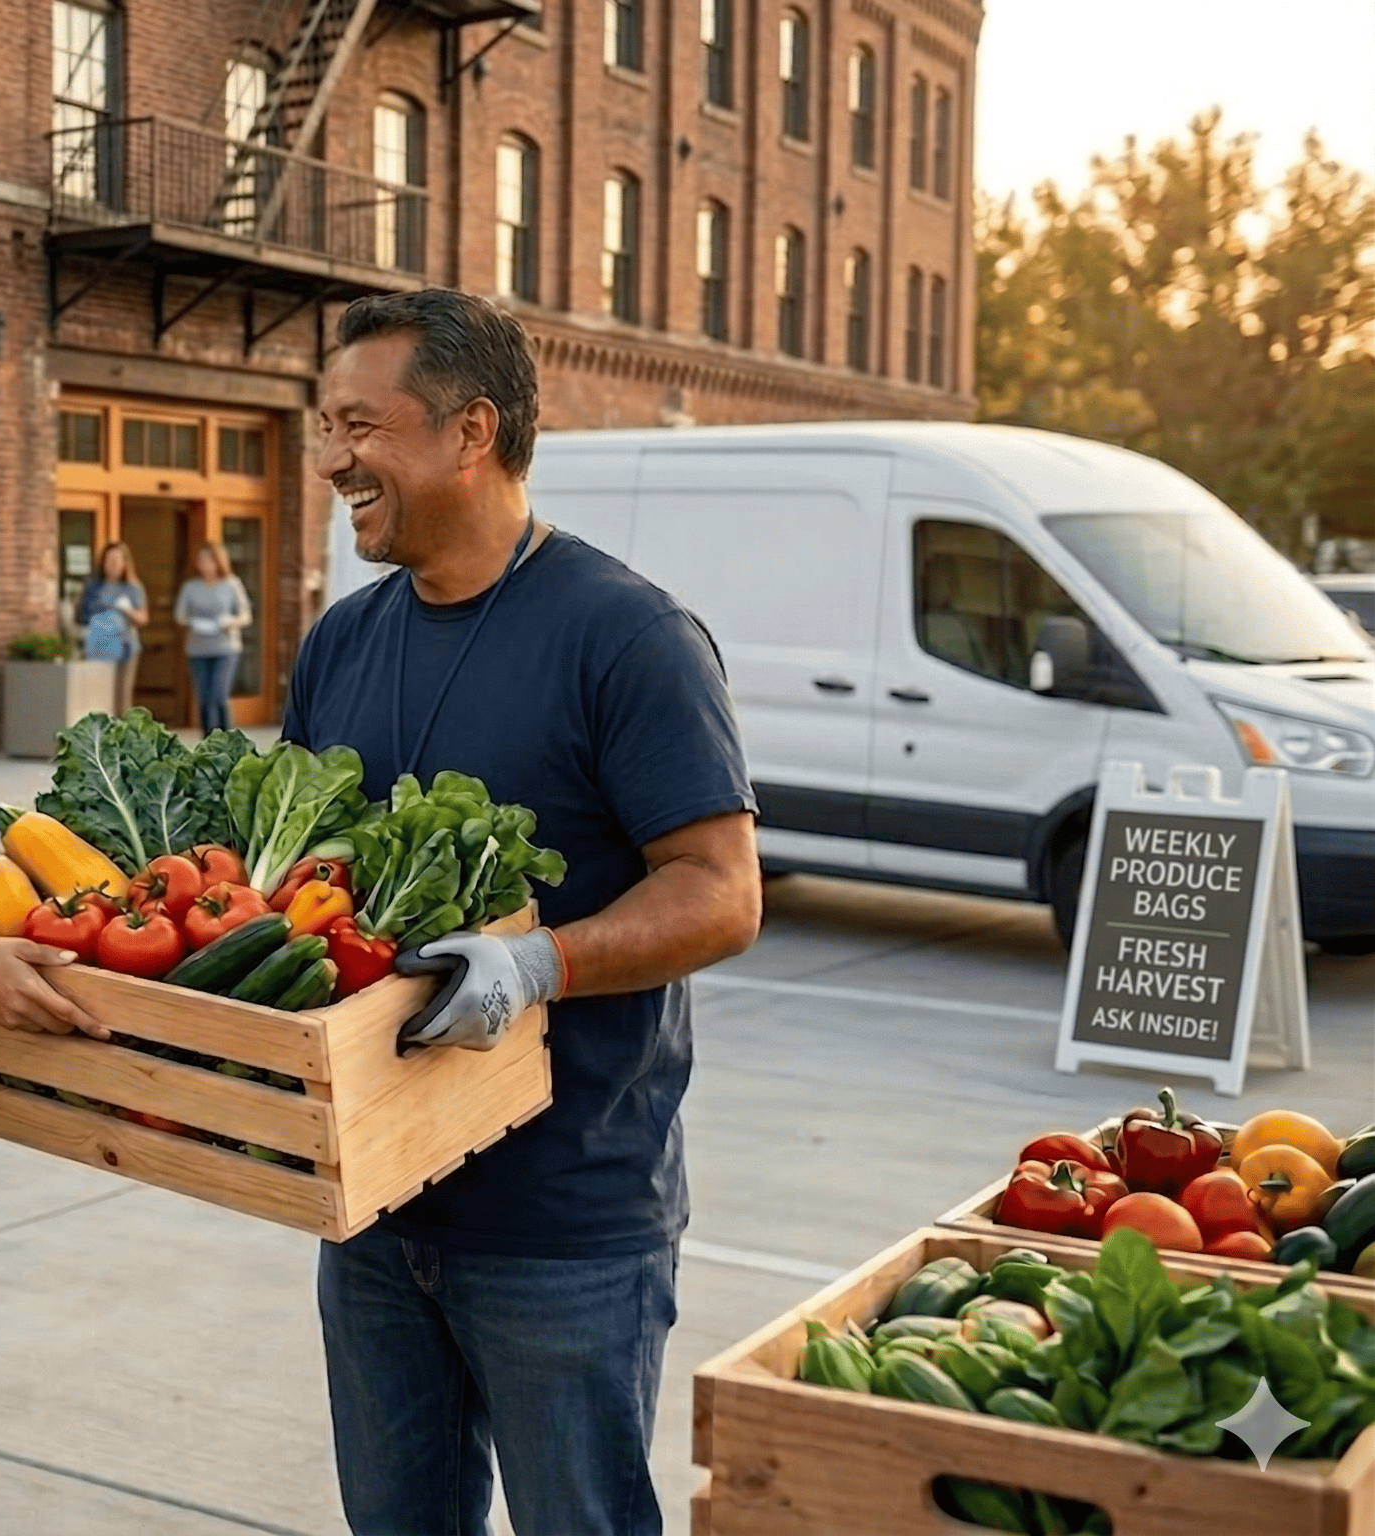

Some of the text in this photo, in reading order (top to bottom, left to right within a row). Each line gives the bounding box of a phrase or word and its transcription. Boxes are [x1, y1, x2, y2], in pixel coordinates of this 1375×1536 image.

[1125, 827, 1237, 859] WEEKLY
[1110, 857, 1243, 892] PRODUCE
[1133, 890, 1207, 921] BAGS
[1117, 936, 1208, 970] FRESH
[1096, 966, 1225, 1005] HARVEST
[1091, 1007, 1219, 1041] ASK INSIDE!
